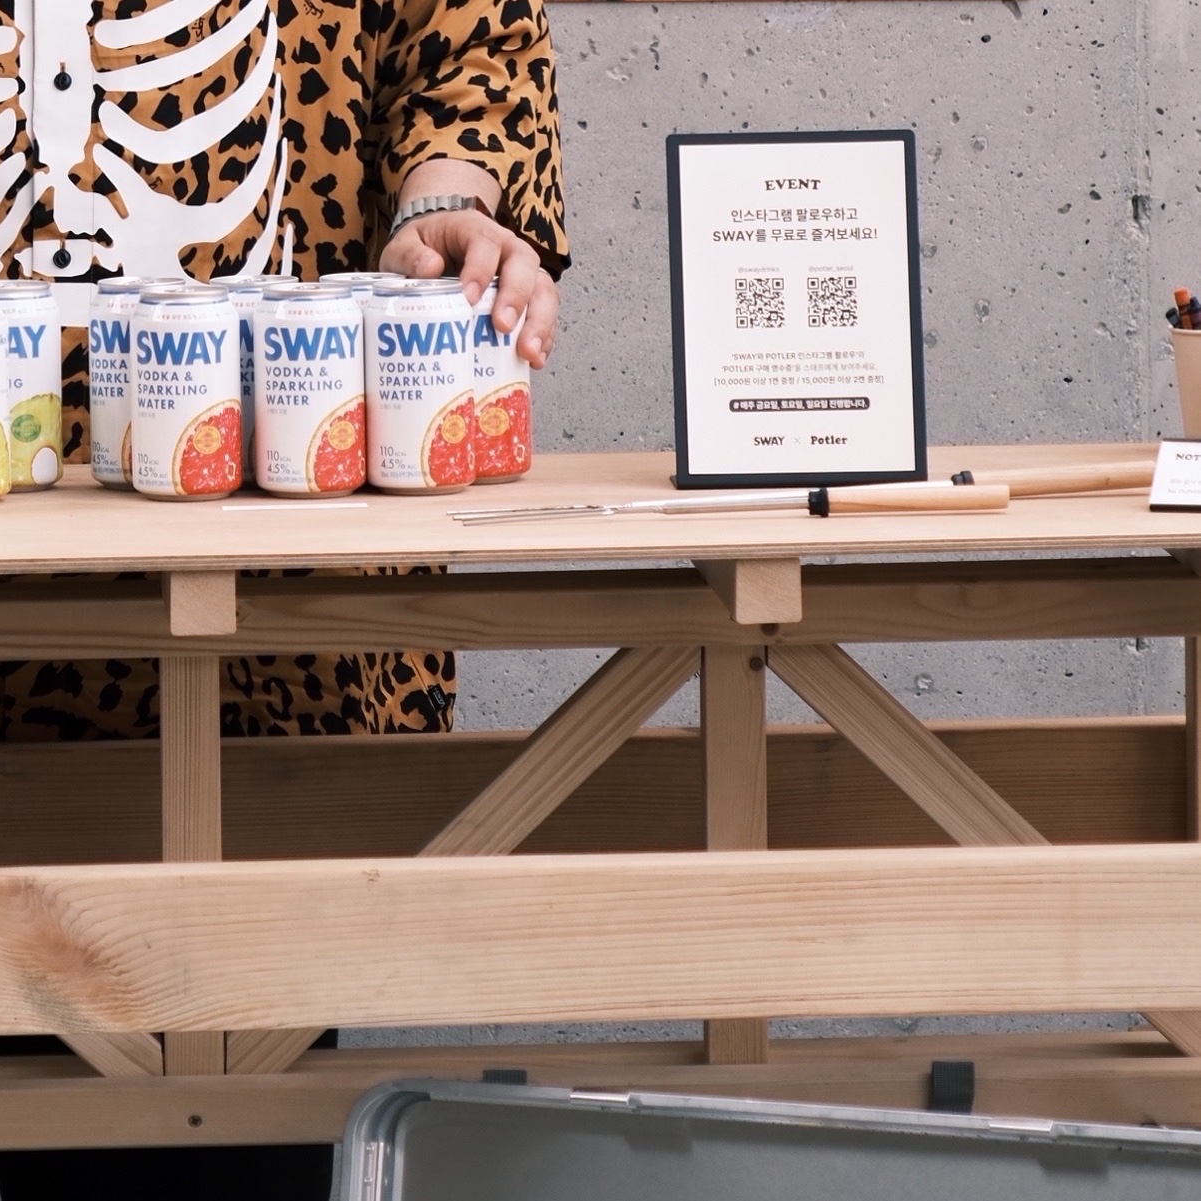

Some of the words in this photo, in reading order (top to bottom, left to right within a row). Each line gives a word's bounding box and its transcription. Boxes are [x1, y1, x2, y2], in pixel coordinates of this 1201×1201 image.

[765, 178, 821, 191] EVENT
[731, 209, 793, 223] 인스타그램
[796, 207, 858, 222] 팔로우하고
[712, 229, 767, 243] SWAY를
[771, 229, 808, 241] 무료로
[811, 227, 878, 241] 즐겨보세요!
[8, 325, 47, 359] AY
[90, 319, 130, 354] SW
[264, 324, 359, 361] SWAY
[377, 319, 470, 357] SWAY
[137, 329, 227, 366] SWAY
[765, 352, 796, 360] POTLER
[91, 359, 128, 370] VODKA
[379, 362, 427, 373] VODKA
[432, 361, 441, 372] &
[137, 370, 179, 381] VODKA
[184, 371, 193, 381] &
[265, 367, 314, 377] VODKA
[319, 367, 328, 377] &
[91, 373, 130, 384] SPARKL
[379, 374, 455, 387] SPARKLING
[91, 386, 124, 397] WATER
[138, 384, 208, 395] SPARKLING
[266, 380, 343, 391] SPARKLING
[266, 395, 309, 406] WATER
[379, 390, 423, 401] WATER
[138, 397, 175, 409] WATER
[754, 436, 785, 446] SWAY
[811, 435, 848, 445] Potler
[267, 463, 290, 475] 4.5%
[381, 459, 406, 470] 4.5%
[138, 466, 158, 478] 4.5%
